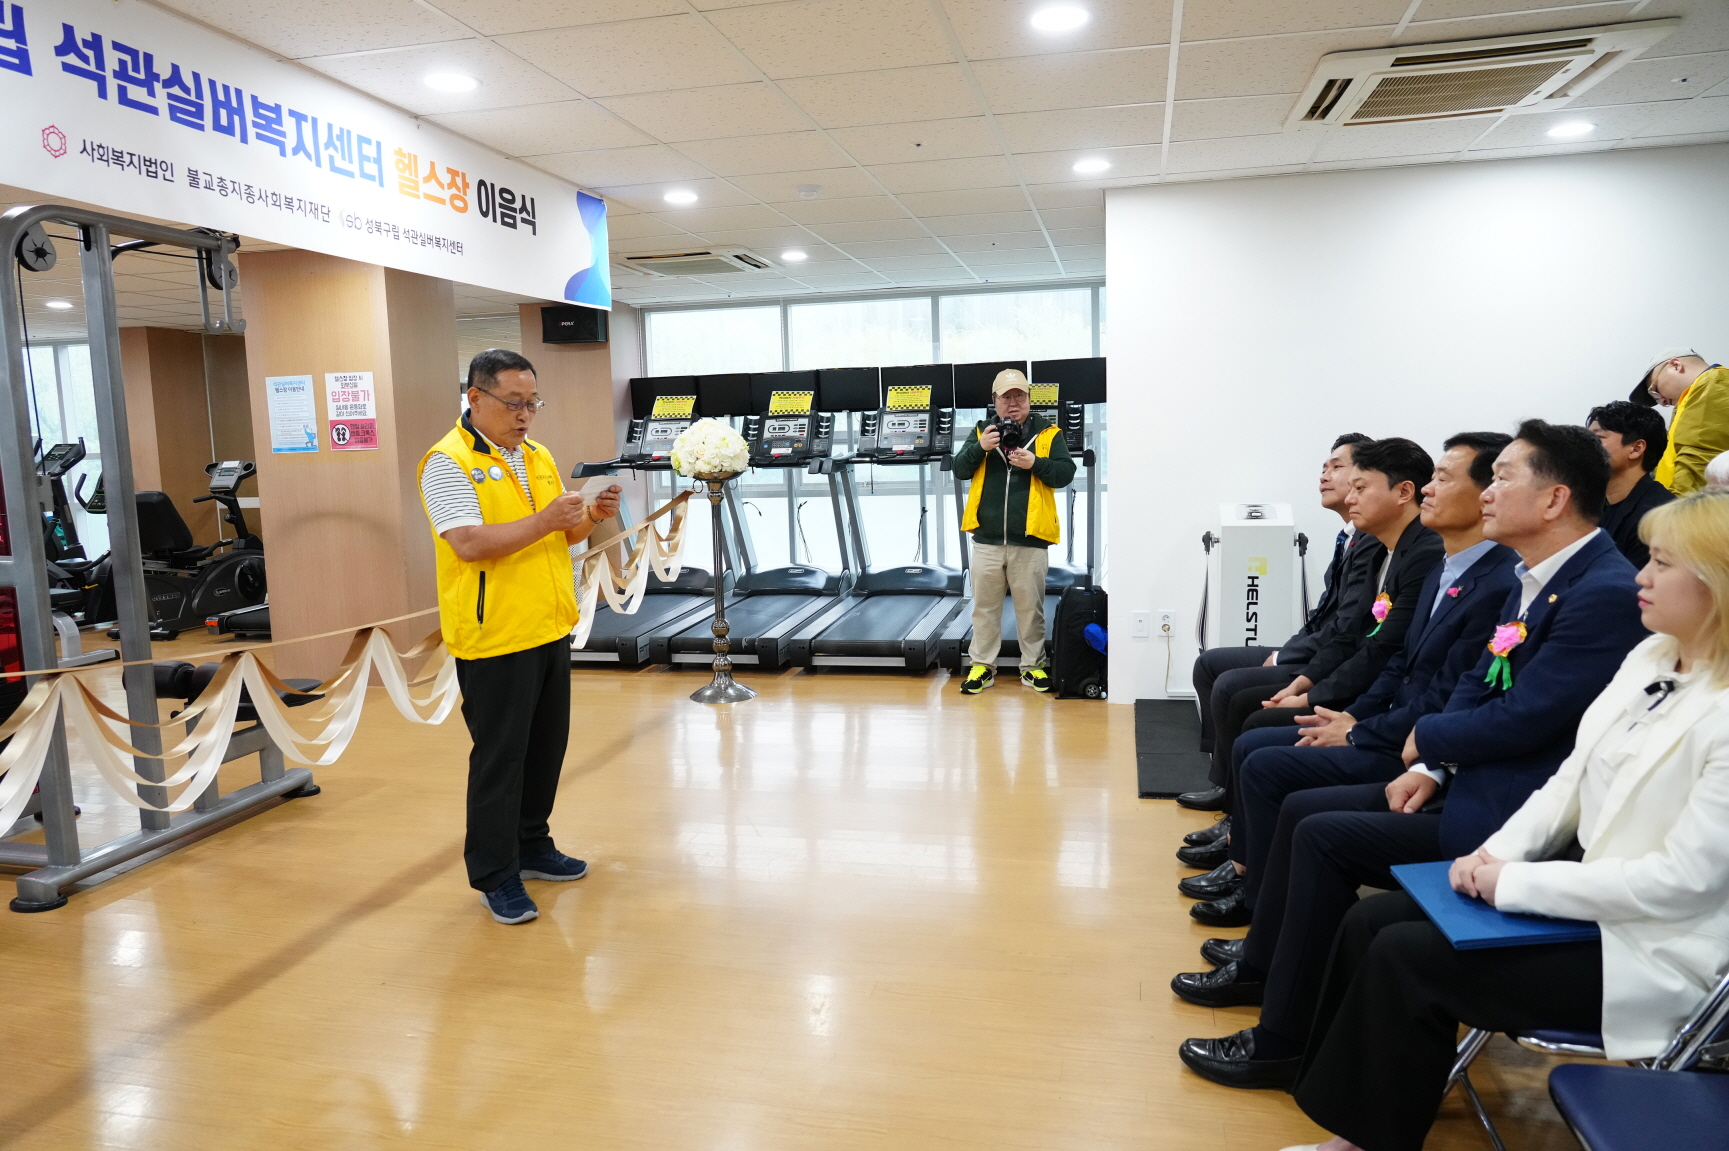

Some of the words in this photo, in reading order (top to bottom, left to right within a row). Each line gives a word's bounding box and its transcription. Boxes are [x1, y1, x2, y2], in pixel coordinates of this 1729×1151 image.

[54, 22, 384, 188] 석관실버복지센터
[393, 147, 470, 214] 헬스장
[477, 178, 537, 236] 이음식
[79, 138, 175, 183] 사회복지법인
[186, 166, 331, 224] 불교총지종사회복지재단
[365, 217, 400, 241] 성북구립
[402, 227, 464, 256] 석관실버복지센터
[330, 389, 371, 403] 입장불가
